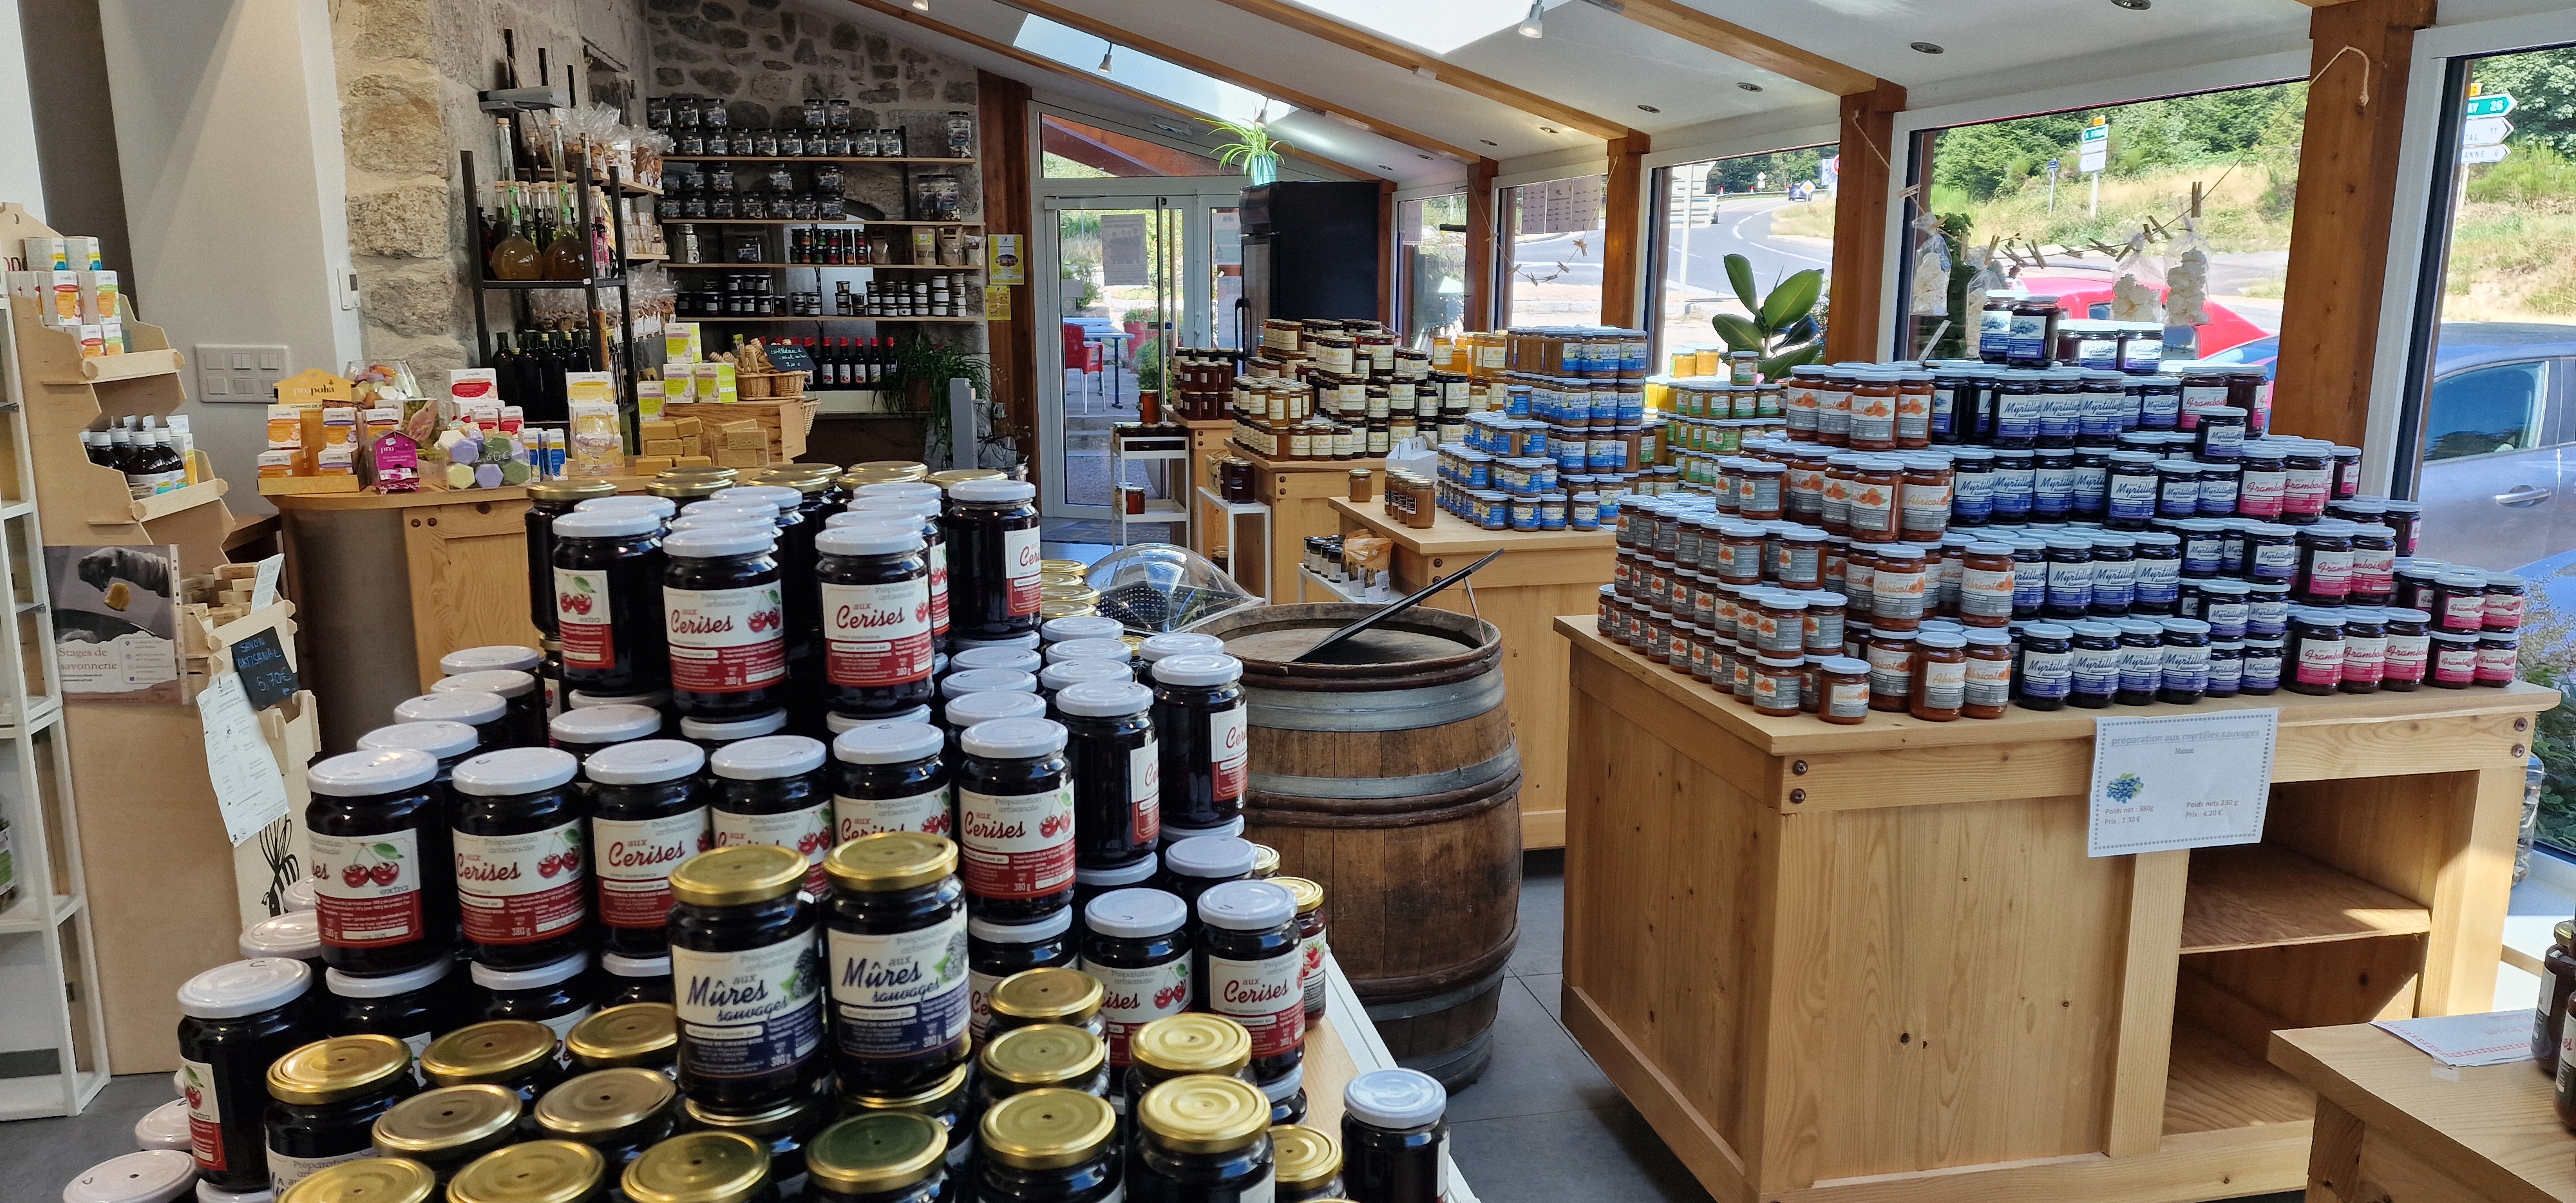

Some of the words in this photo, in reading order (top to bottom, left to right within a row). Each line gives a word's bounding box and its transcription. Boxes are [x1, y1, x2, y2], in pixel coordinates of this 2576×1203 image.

[2489, 99, 2505, 112] 26
[2464, 150, 2486, 158] ANNE
[671, 609, 734, 634] Cerises
[837, 605, 905, 629] Cerises
[59, 647, 92, 658] Stages
[95, 647, 108, 657] de
[61, 662, 118, 670] savonnerie
[2164, 734, 2180, 742] aux
[2182, 730, 2219, 743] myrtilles
[2222, 729, 2260, 739] sauvages
[976, 811, 991, 820] aux
[964, 811, 1026, 838] Cerises
[484, 837, 538, 846] Préparation
[627, 839, 648, 848] aux
[609, 840, 685, 867] Cerises
[457, 853, 522, 882] Cerises
[380, 885, 409, 895] extra
[511, 927, 525, 936] 380
[889, 956, 912, 966] aux
[733, 974, 757, 985] aux
[842, 958, 922, 988] Mûres
[1112, 970, 1156, 978] Préparation
[1242, 978, 1261, 986] aux
[687, 976, 768, 1007] Mûres
[873, 978, 940, 1003] sauvages
[1224, 979, 1289, 1003] Cerises
[1102, 990, 1141, 1010] ises
[717, 996, 789, 1022] sauvages
